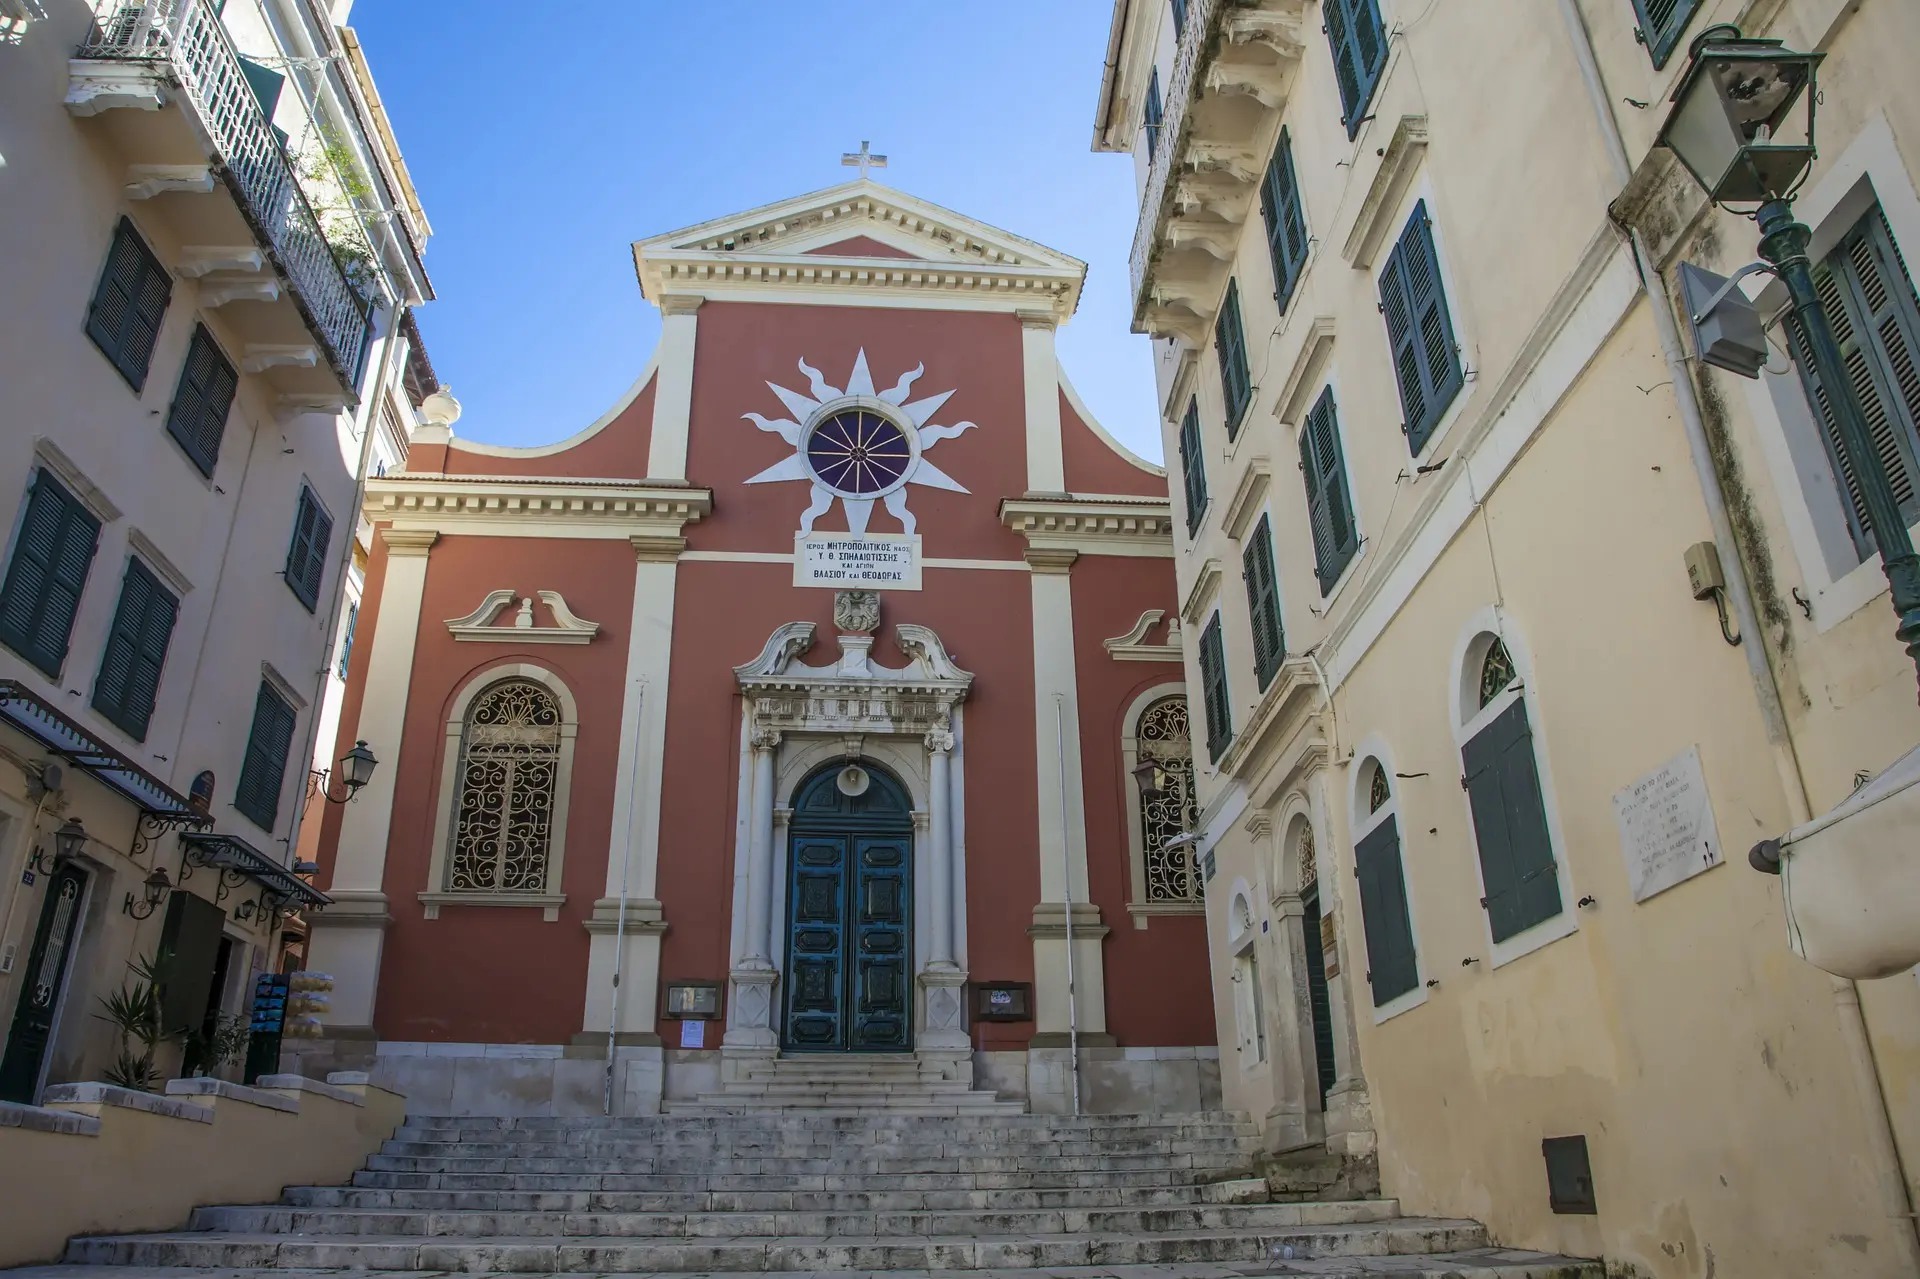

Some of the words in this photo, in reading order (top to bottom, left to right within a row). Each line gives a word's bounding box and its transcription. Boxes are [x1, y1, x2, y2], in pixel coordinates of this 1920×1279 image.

[827, 541, 891, 552] ΜΗΤΡΟΠΟΛΙΤΙΚΟΣ
[839, 552, 898, 562] ΣΠΗΛΑΙΩΤΙΣΣΗΣ
[813, 569, 846, 579] ΒΛΑΣΙΟΥ
[862, 571, 902, 580] ΘΕΟΔΩΡΑΣ
[24, 873, 33, 883] 22
